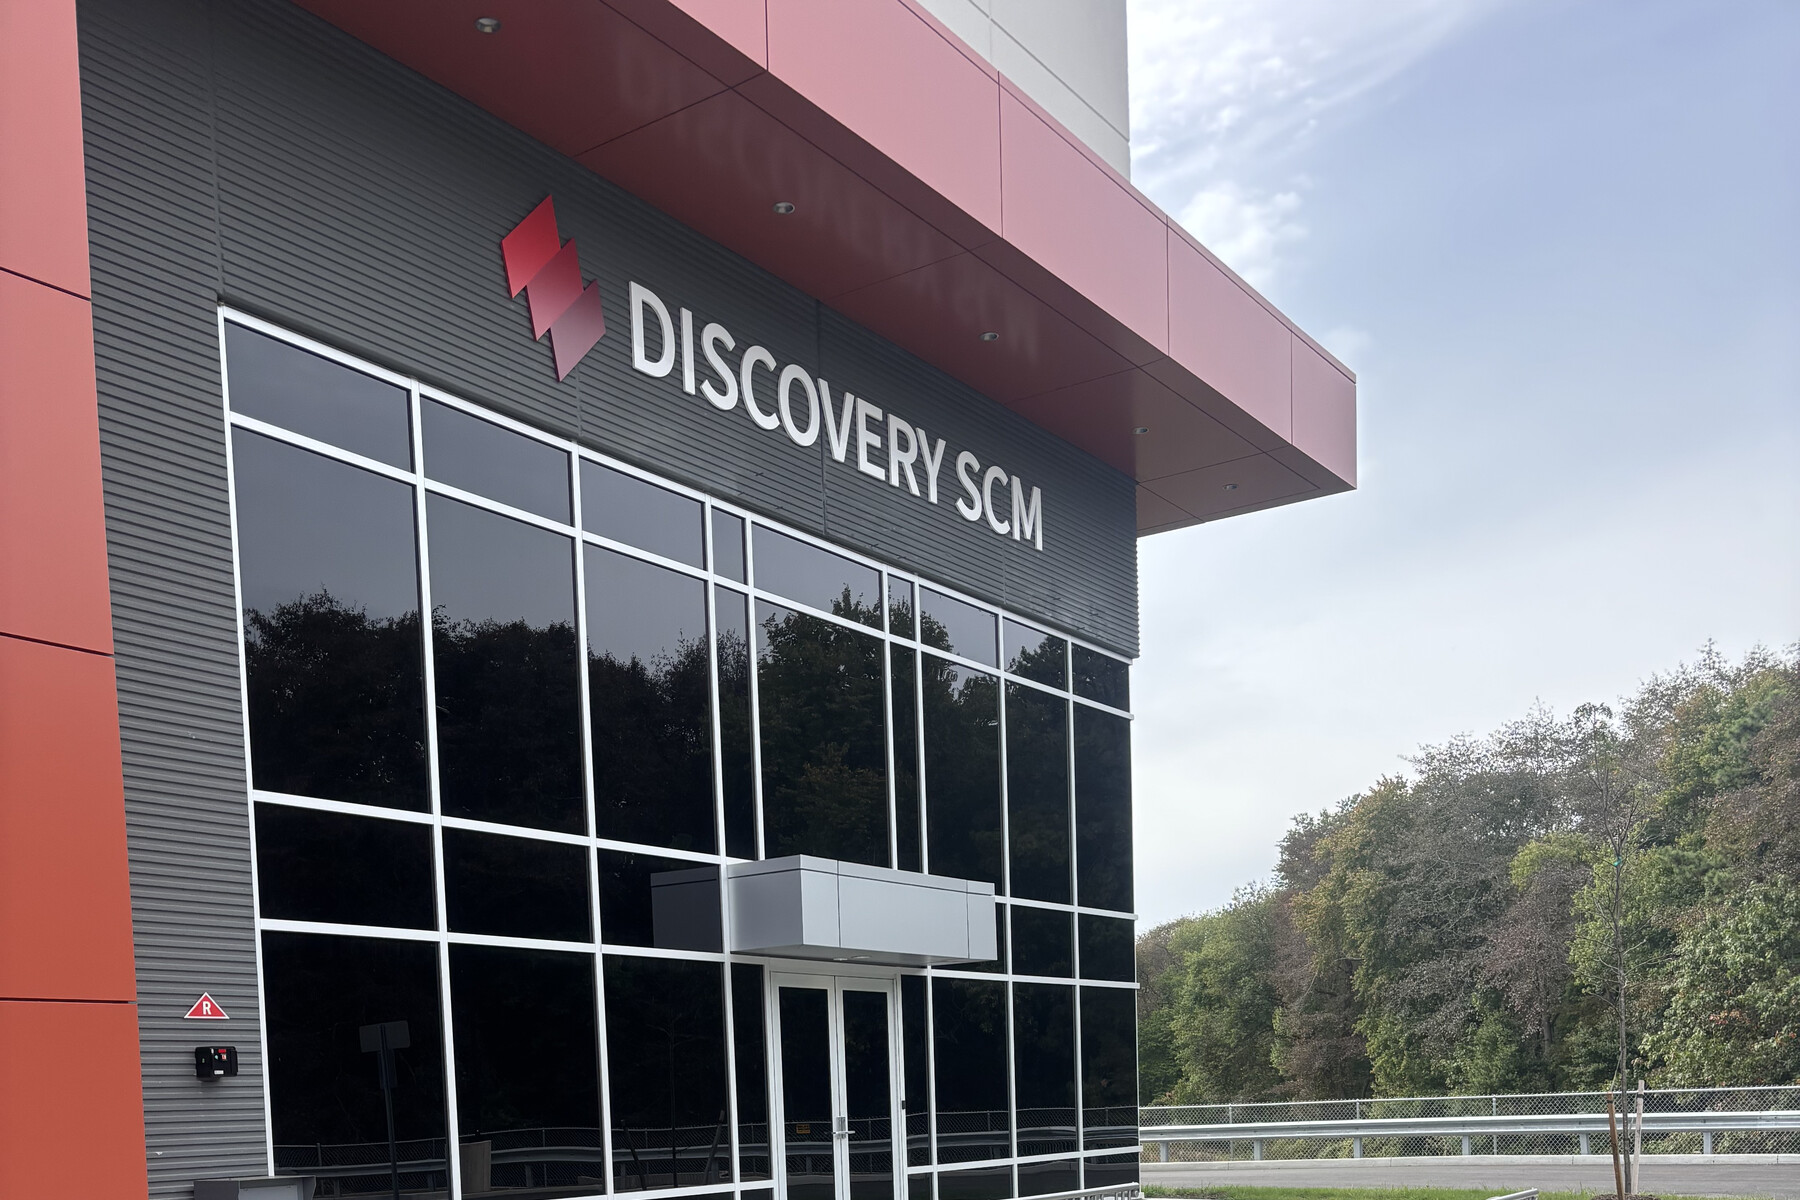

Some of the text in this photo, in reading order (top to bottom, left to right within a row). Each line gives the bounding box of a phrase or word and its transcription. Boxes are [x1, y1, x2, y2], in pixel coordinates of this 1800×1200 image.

[629, 280, 1043, 551] DISCOVERY SCM
[202, 1001, 212, 1015] R
